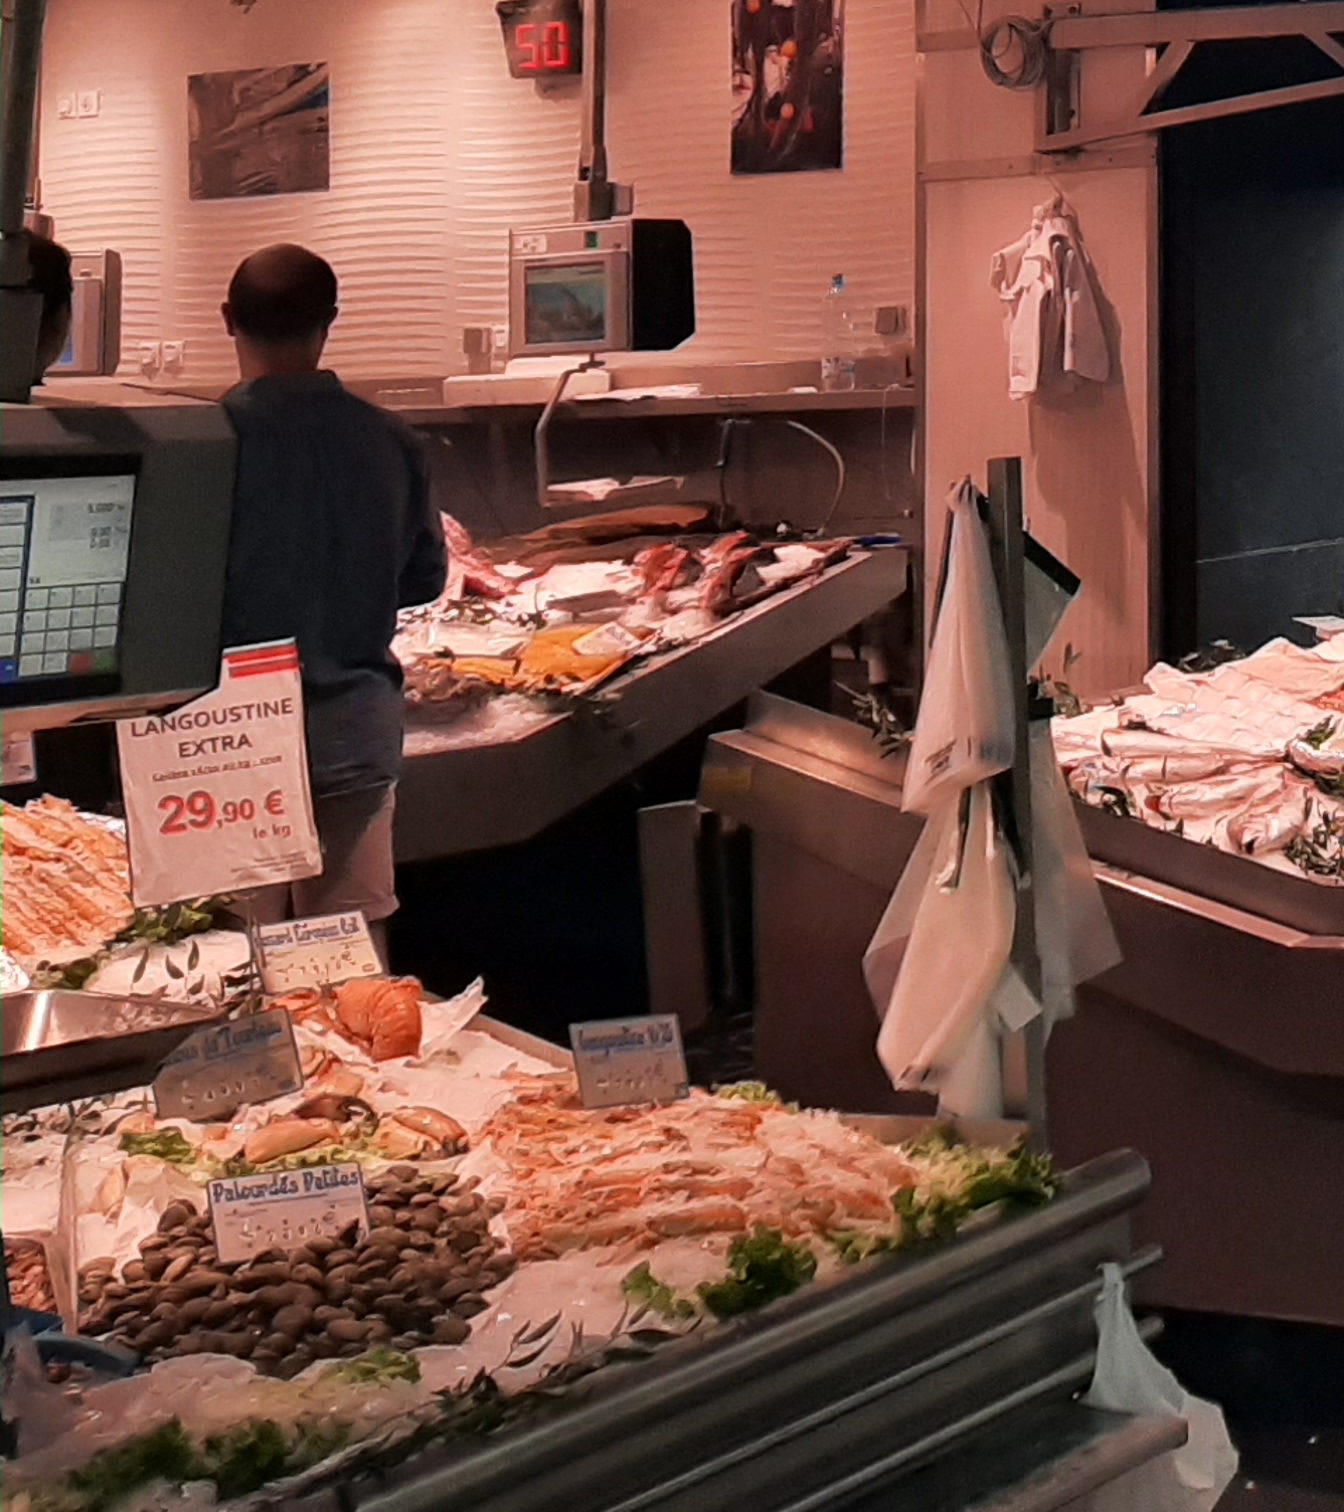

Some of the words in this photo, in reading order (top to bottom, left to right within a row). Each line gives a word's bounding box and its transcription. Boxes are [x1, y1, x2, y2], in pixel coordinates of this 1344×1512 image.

[515, 21, 571, 71] 50
[130, 697, 294, 738] LANGOUSTINE
[178, 733, 253, 759] EXTRA
[158, 790, 256, 835] 29,90
[264, 790, 285, 816] €
[253, 827, 267, 839] le
[272, 824, 292, 838] kg
